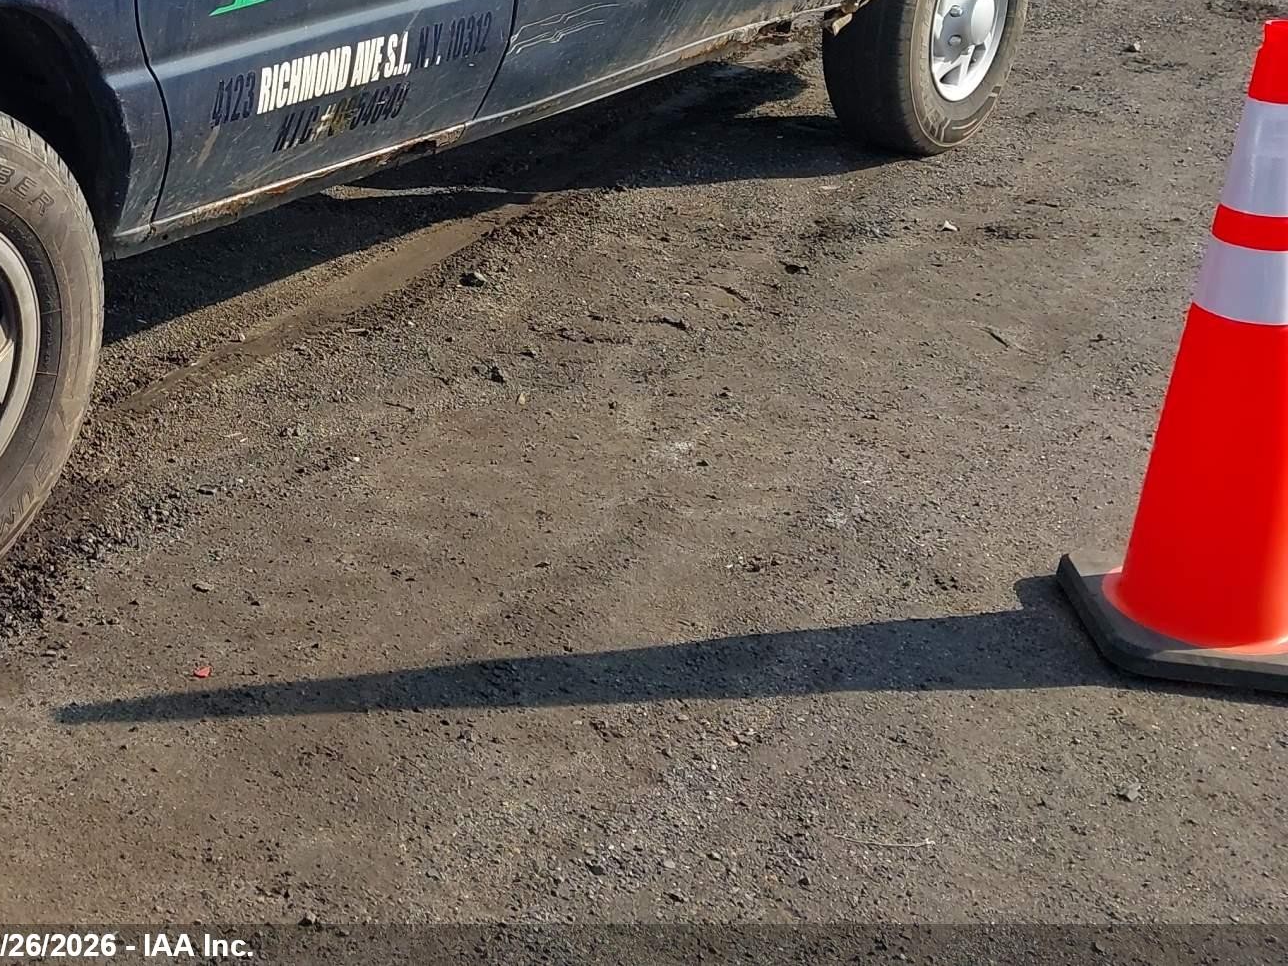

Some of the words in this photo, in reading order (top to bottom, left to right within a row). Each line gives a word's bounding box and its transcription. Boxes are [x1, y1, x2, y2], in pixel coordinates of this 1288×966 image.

[212, 70, 255, 127] 4123
[257, 45, 352, 115] RICHMOND
[351, 36, 386, 86] AVE
[446, 11, 493, 62] 10312
